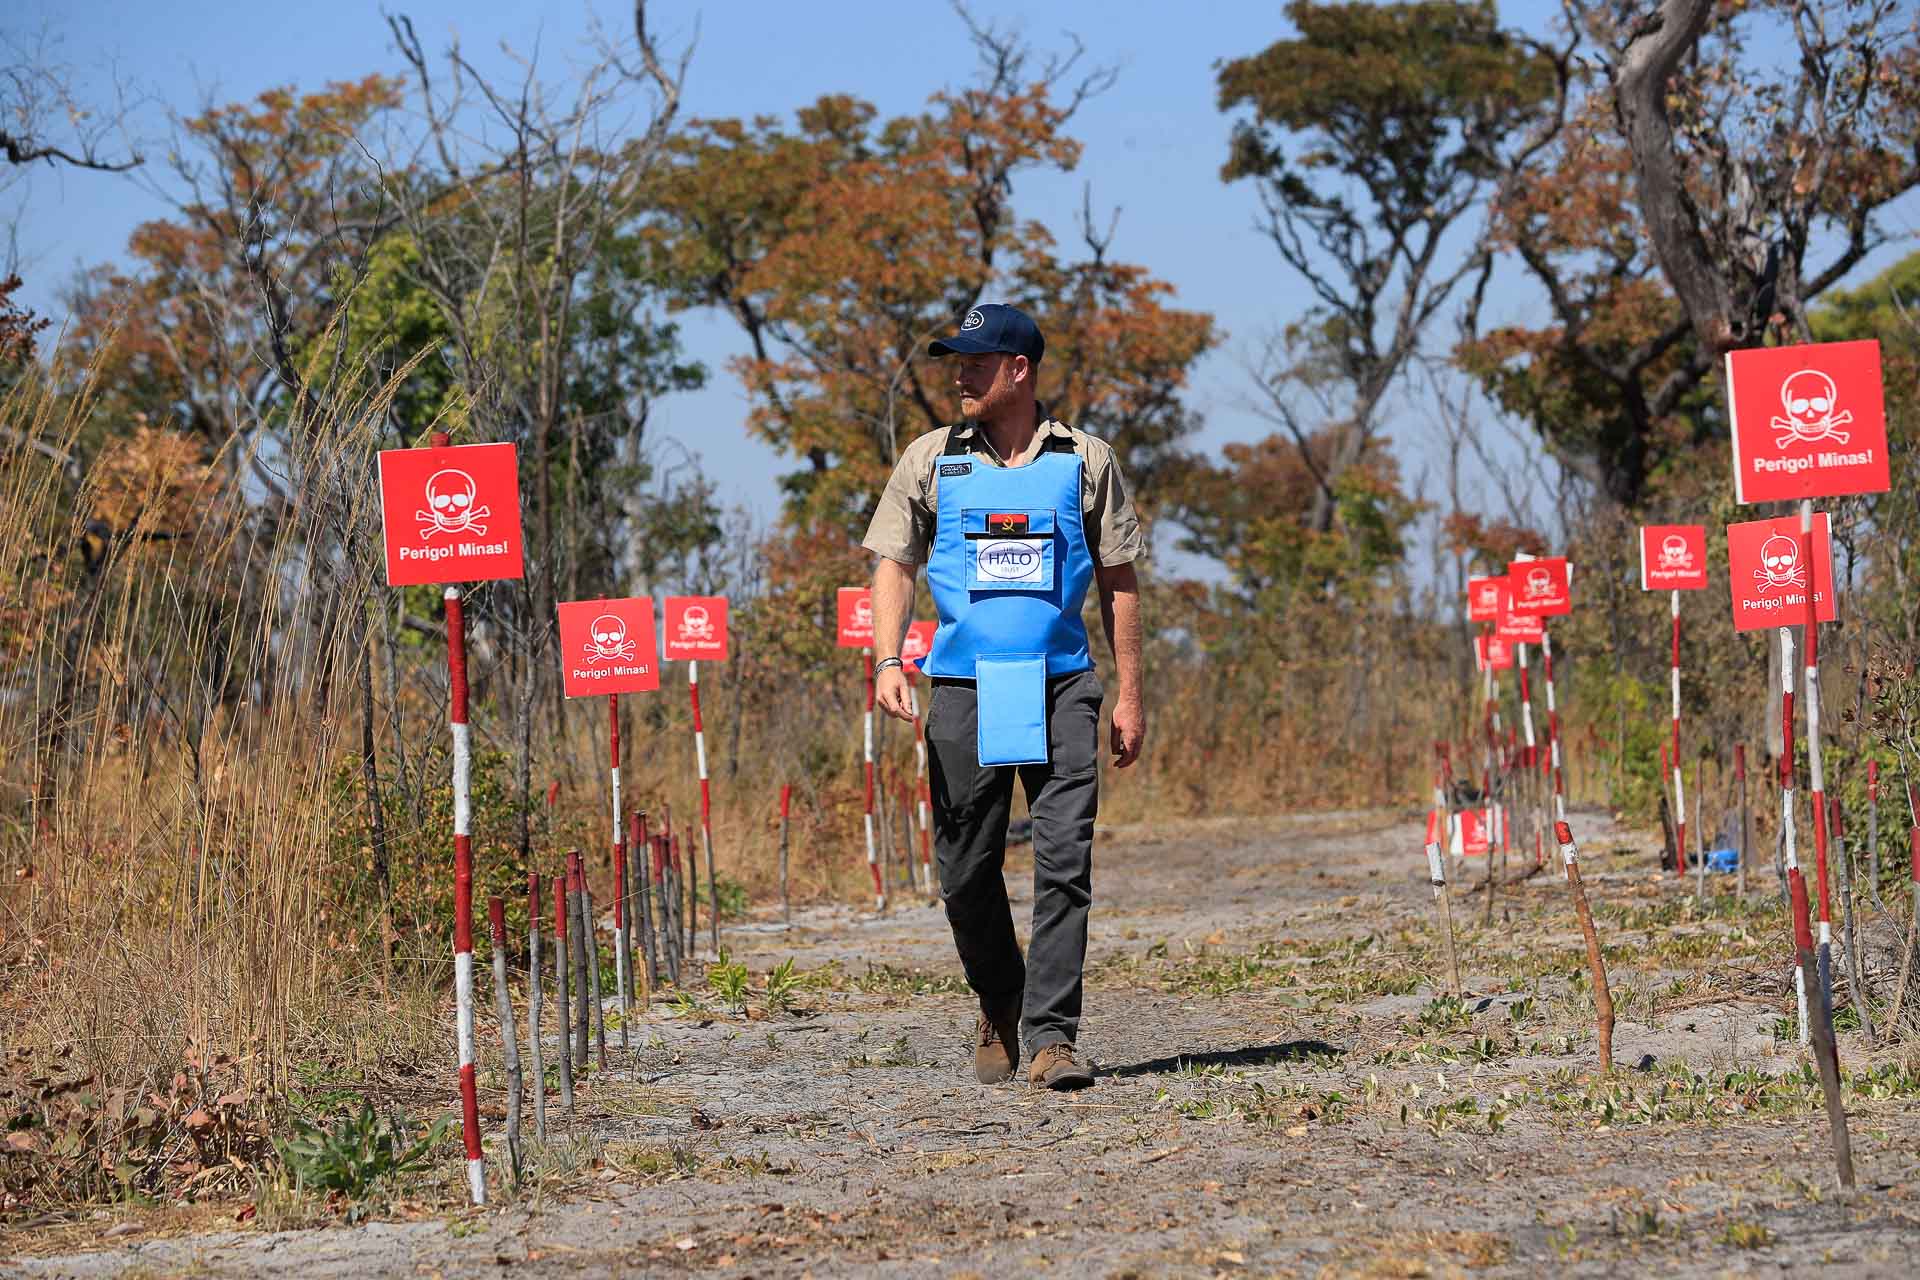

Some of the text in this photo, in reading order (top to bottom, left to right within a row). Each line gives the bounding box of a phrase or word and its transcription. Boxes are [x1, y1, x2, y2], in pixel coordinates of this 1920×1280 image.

[1753, 448, 1873, 474] Perigo! Minas!
[399, 541, 508, 561] Perigo! Minas!
[988, 552, 1032, 566] HALO
[1743, 592, 1824, 610] Perigo! Mins!
[573, 664, 649, 680] Perigo! Minas!
